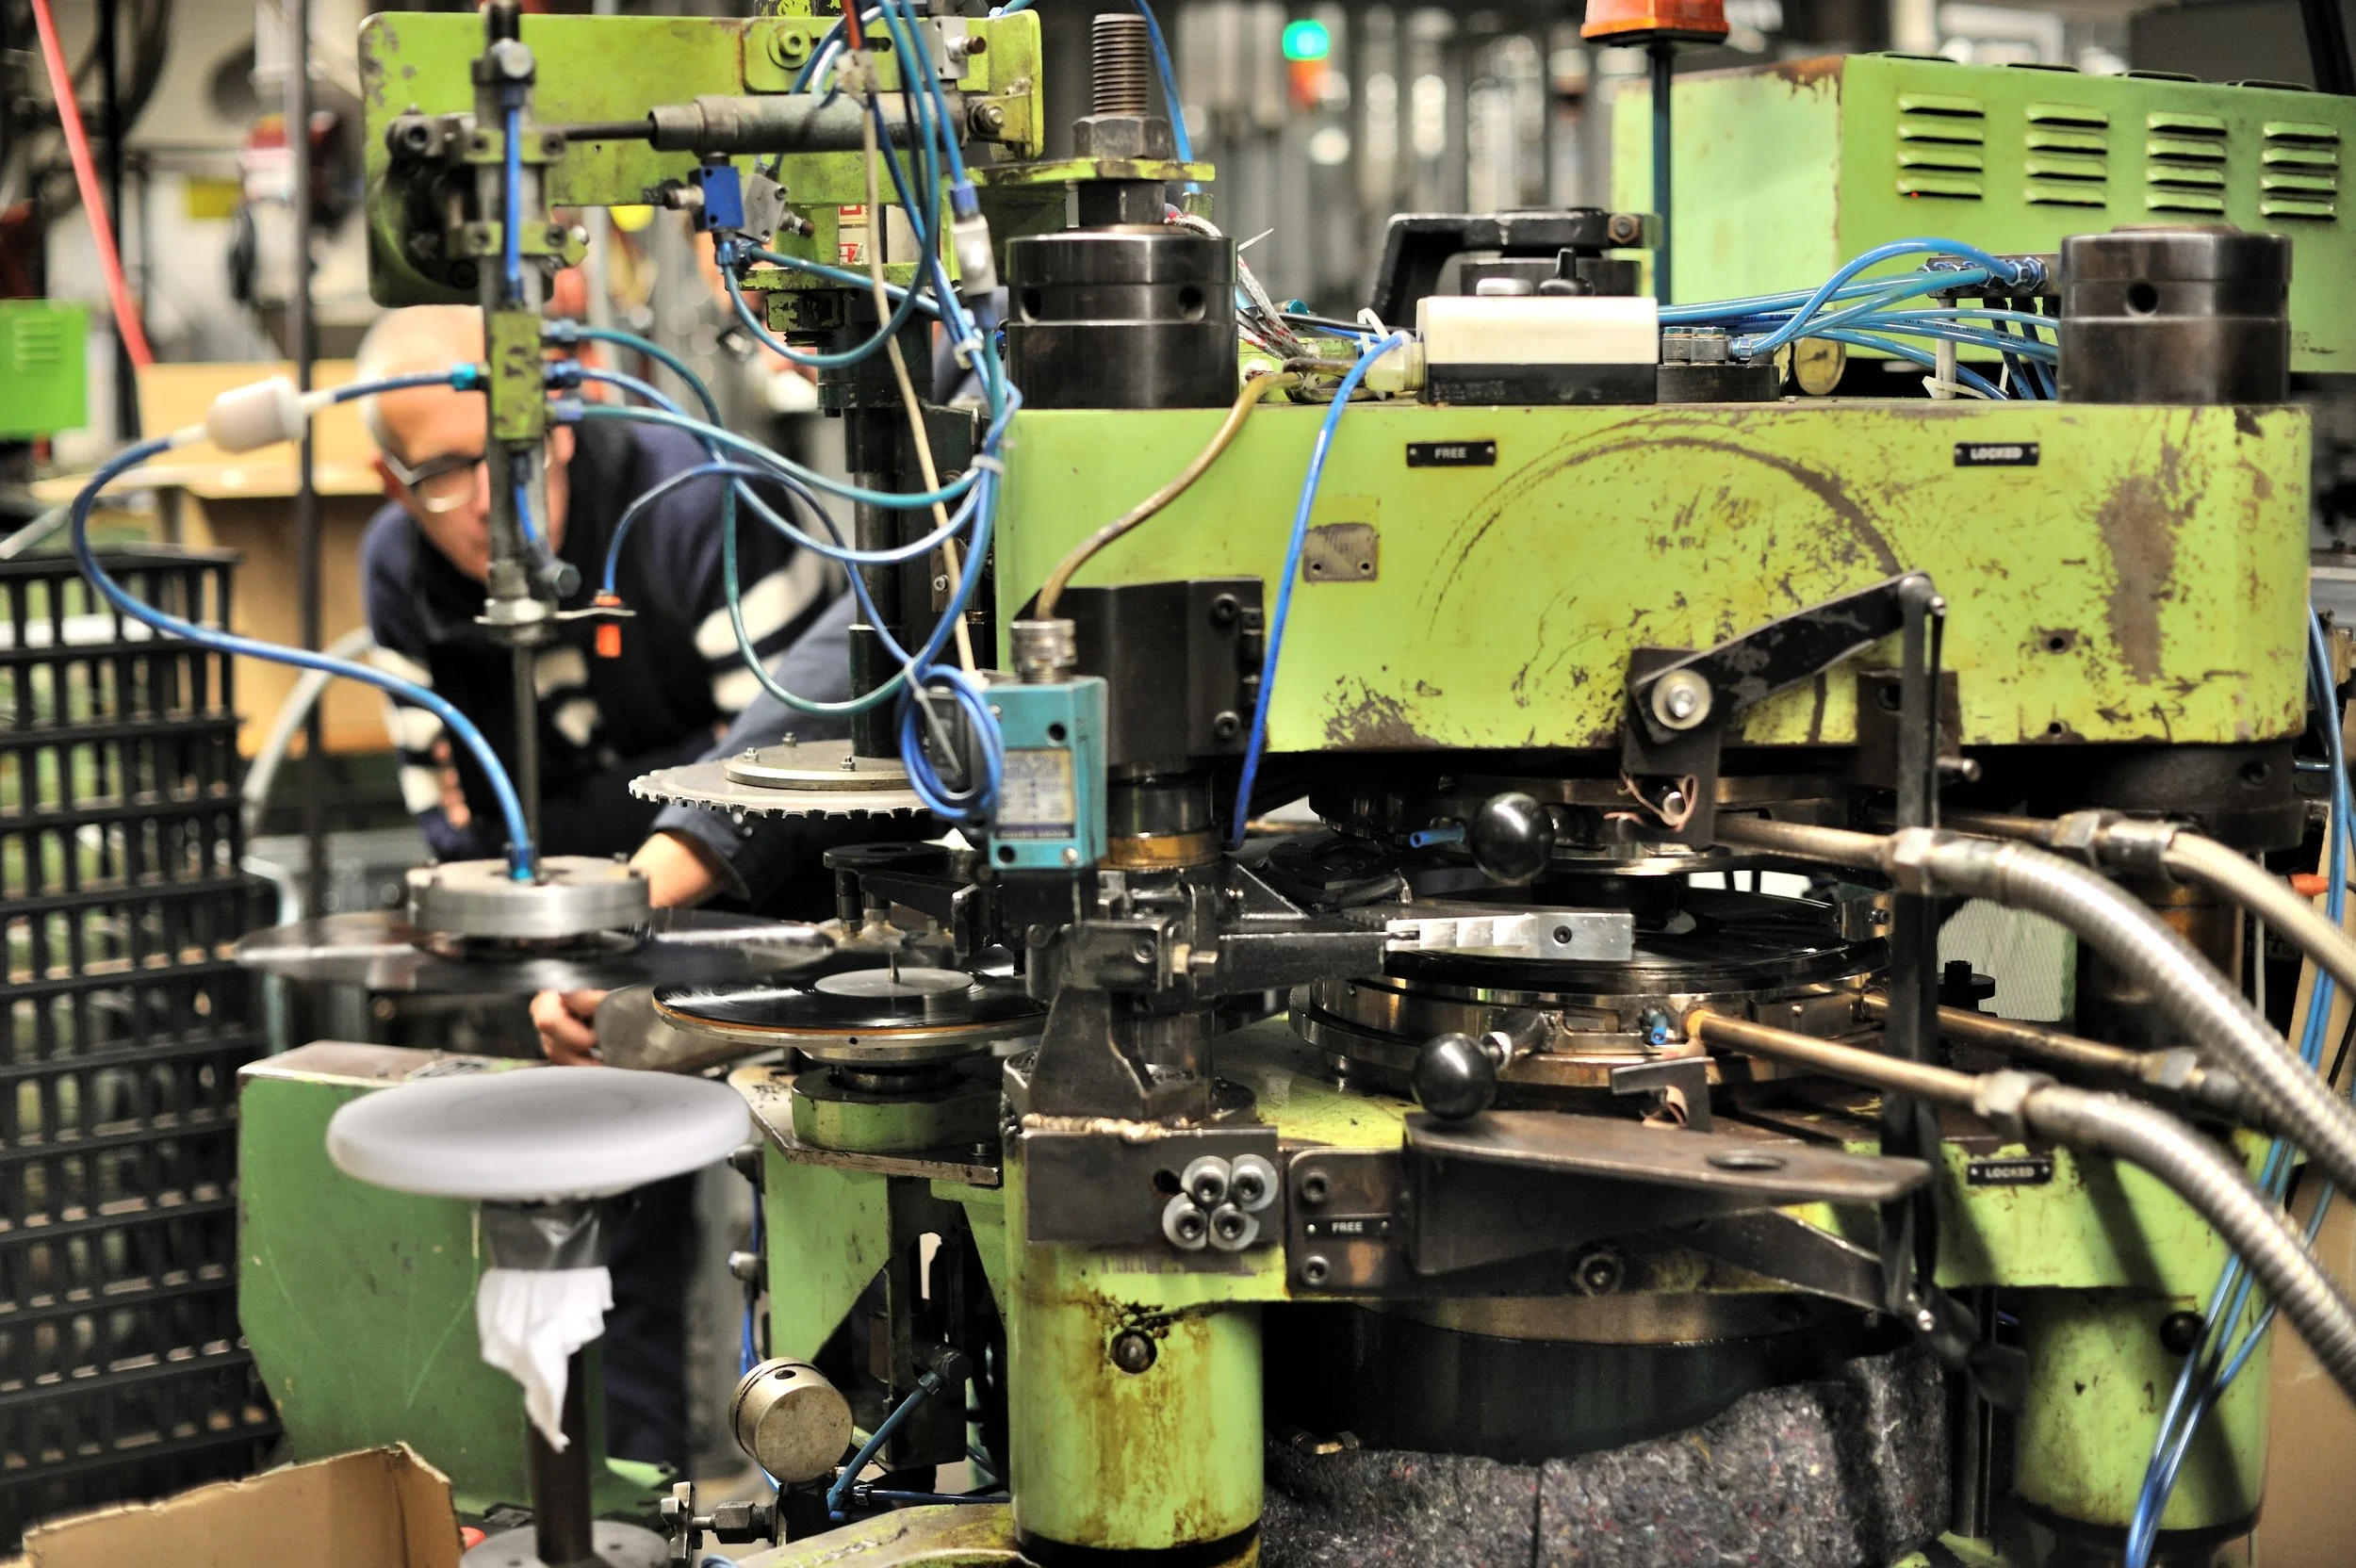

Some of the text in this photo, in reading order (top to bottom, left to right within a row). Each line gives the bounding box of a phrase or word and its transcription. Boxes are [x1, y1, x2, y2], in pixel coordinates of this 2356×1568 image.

[1434, 447, 1467, 459] FREE
[1970, 447, 2023, 461] LOCKED
[1985, 1166, 2036, 1179] LOCKED
[1332, 1221, 1364, 1233] FREE
